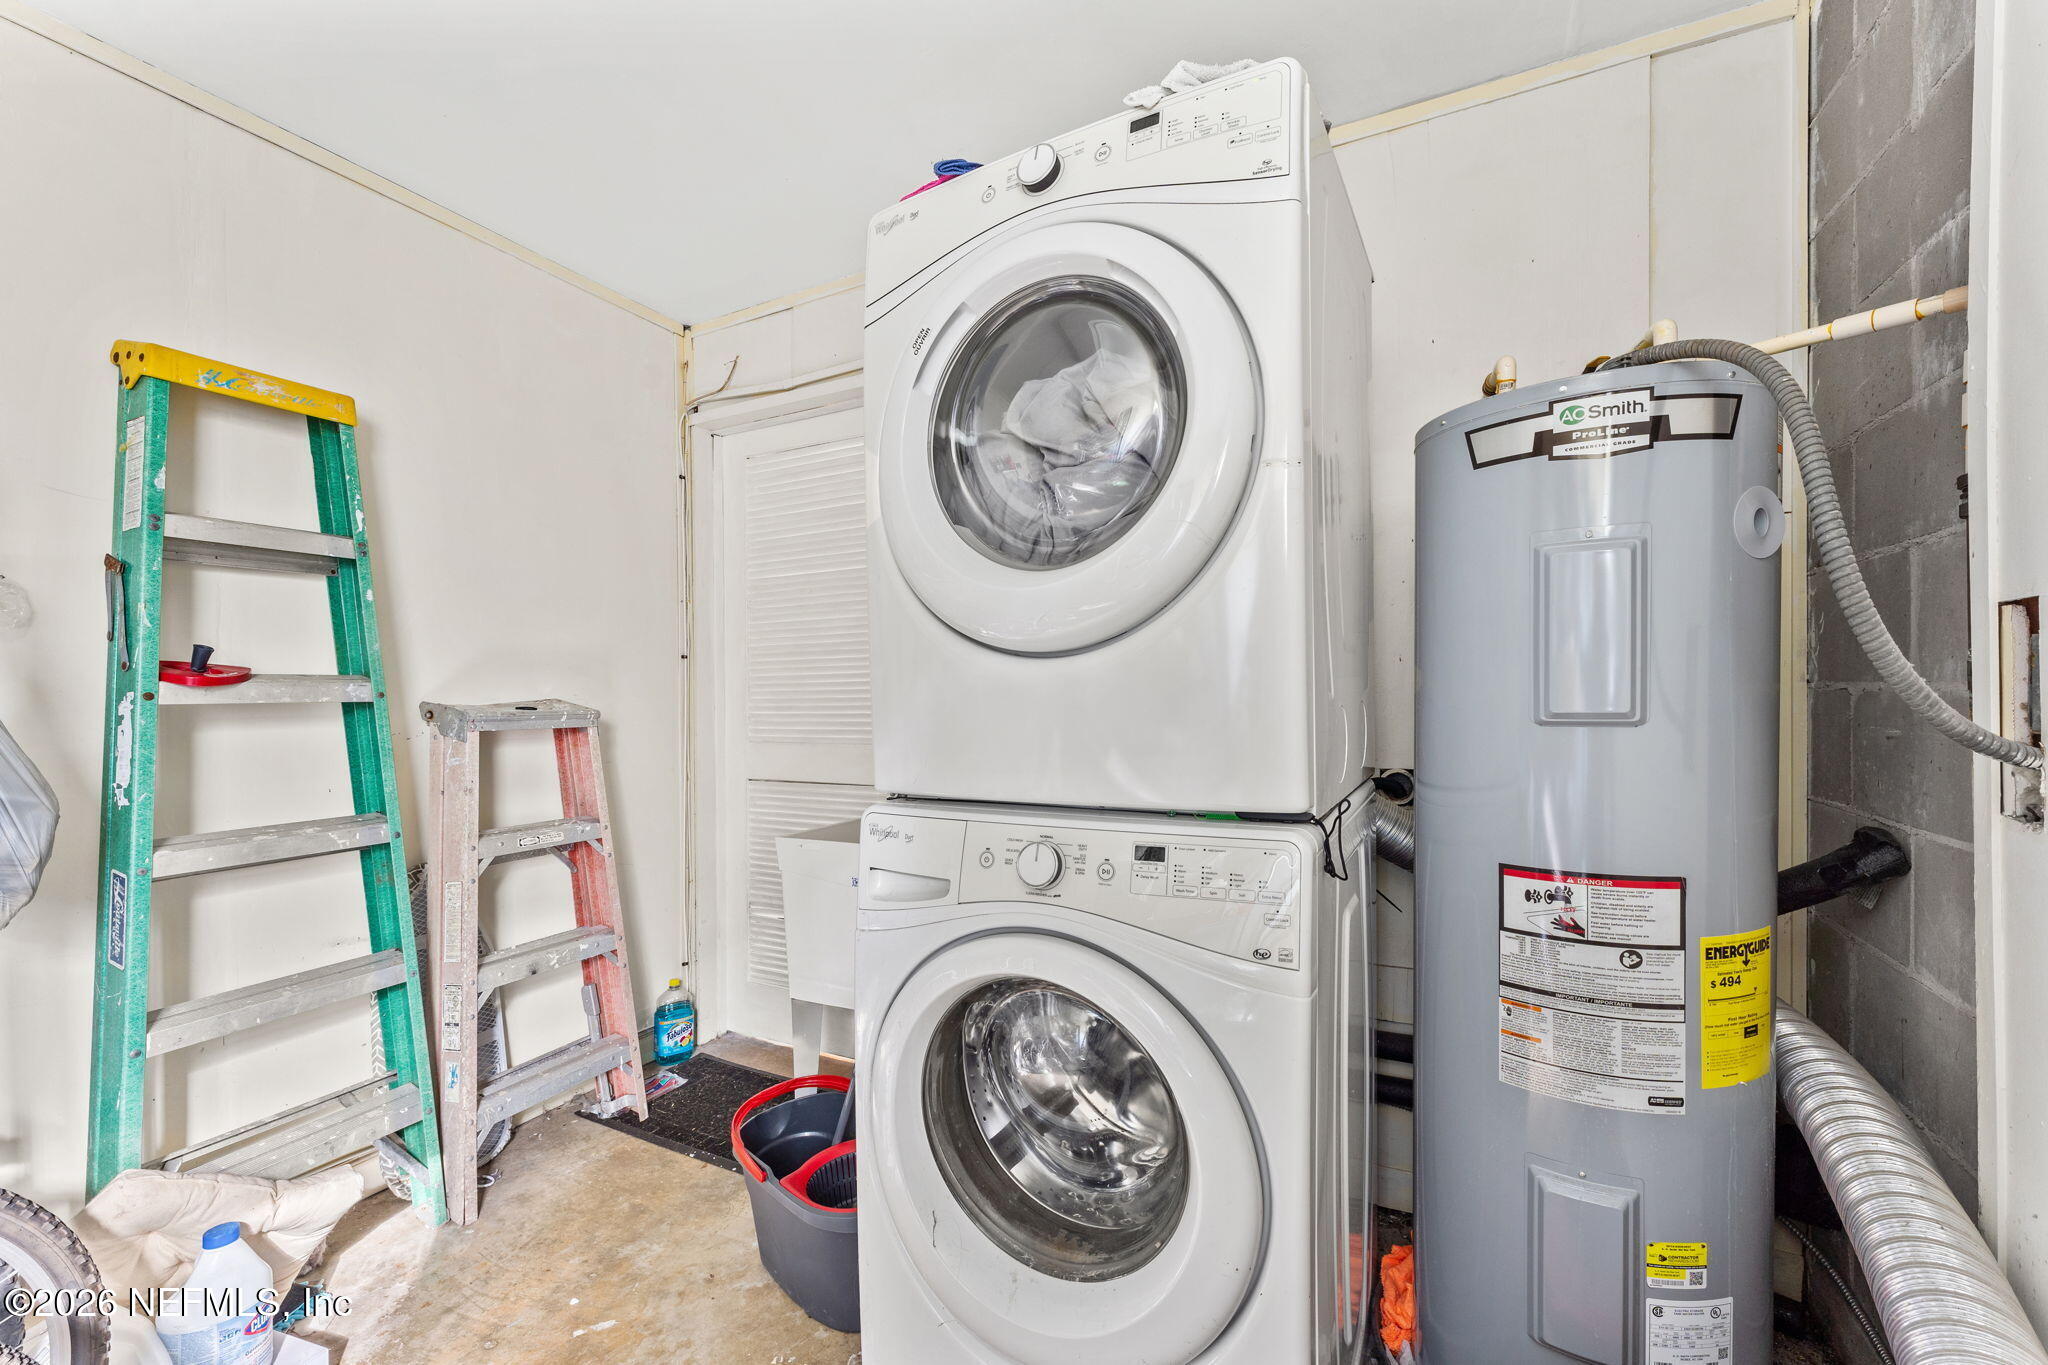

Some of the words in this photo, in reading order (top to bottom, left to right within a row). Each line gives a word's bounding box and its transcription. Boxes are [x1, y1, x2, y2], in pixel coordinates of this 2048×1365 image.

[912, 328, 925, 349] OPEN
[914, 328, 931, 356] OUVRIR
[1564, 443, 1610, 452] COMMERCIA
[870, 826, 900, 842] Whirlpool
[1577, 878, 1614, 887] DANGER
[1705, 936, 1770, 963] ENERGYGUIDE
[1710, 980, 1717, 989] $
[1719, 974, 1742, 988] 494
[1556, 993, 1590, 1002] IMPORTANT
[1594, 998, 1633, 1007] IMPORTANTE
[666, 1024, 692, 1042] Fabuloso
